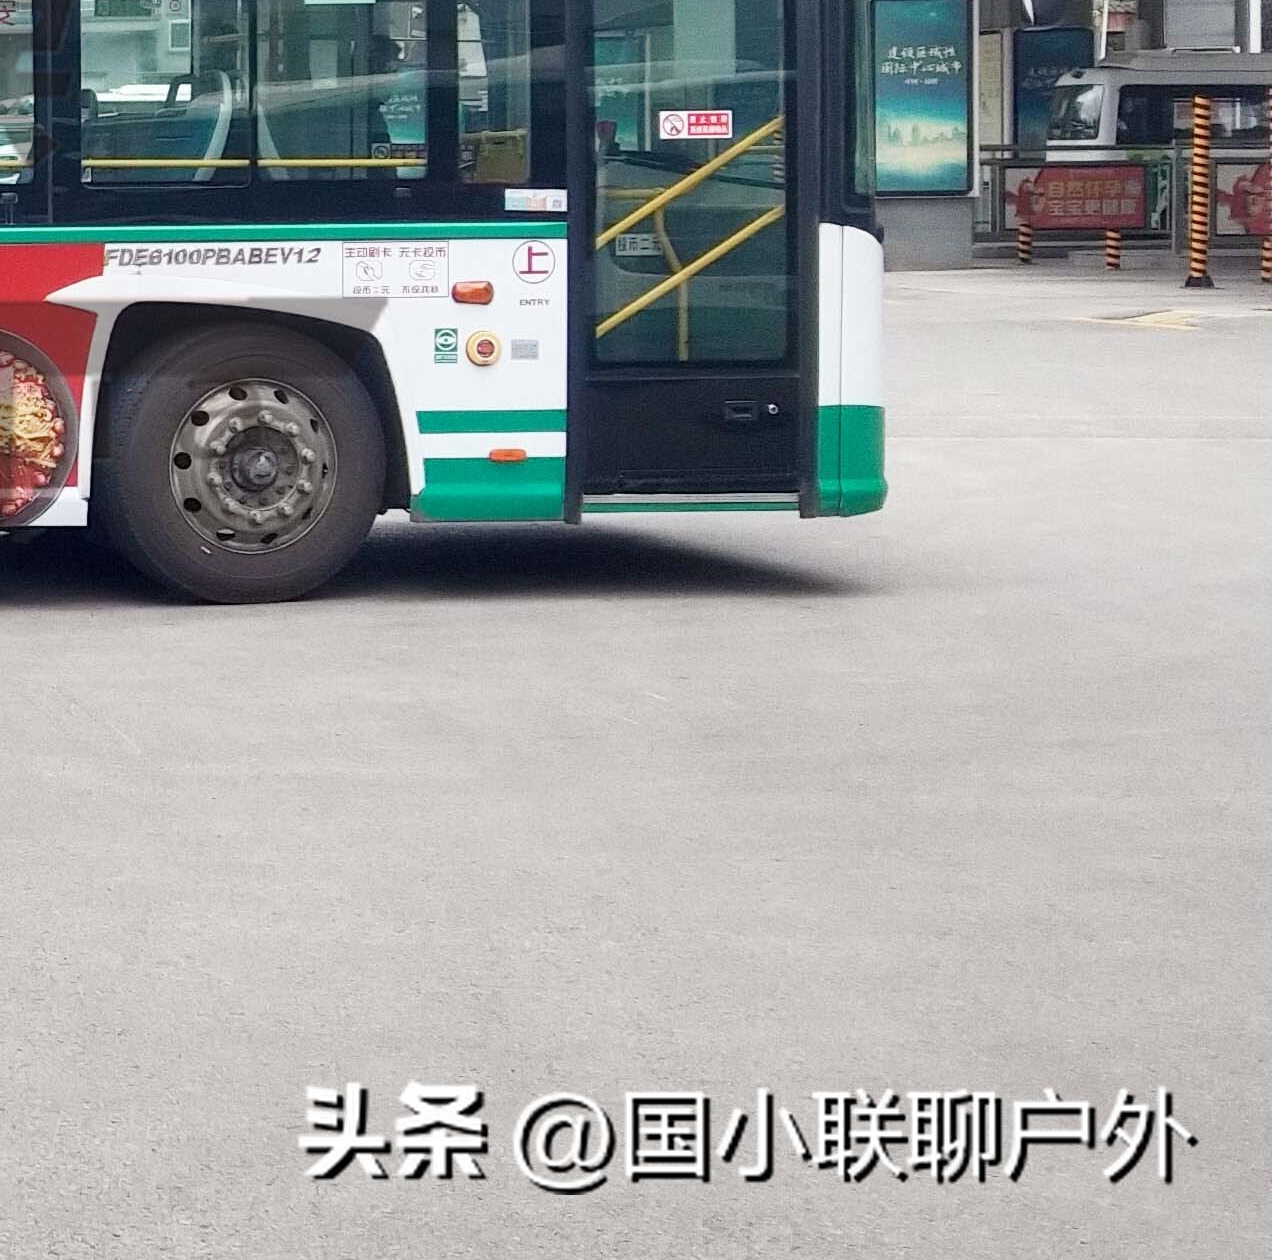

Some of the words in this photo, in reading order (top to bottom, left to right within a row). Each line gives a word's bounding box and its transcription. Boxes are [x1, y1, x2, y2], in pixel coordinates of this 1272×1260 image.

[104, 245, 321, 267] FDE6100PBABEV12
[519, 246, 549, 274] 上
[519, 298, 550, 306] ENTRY
